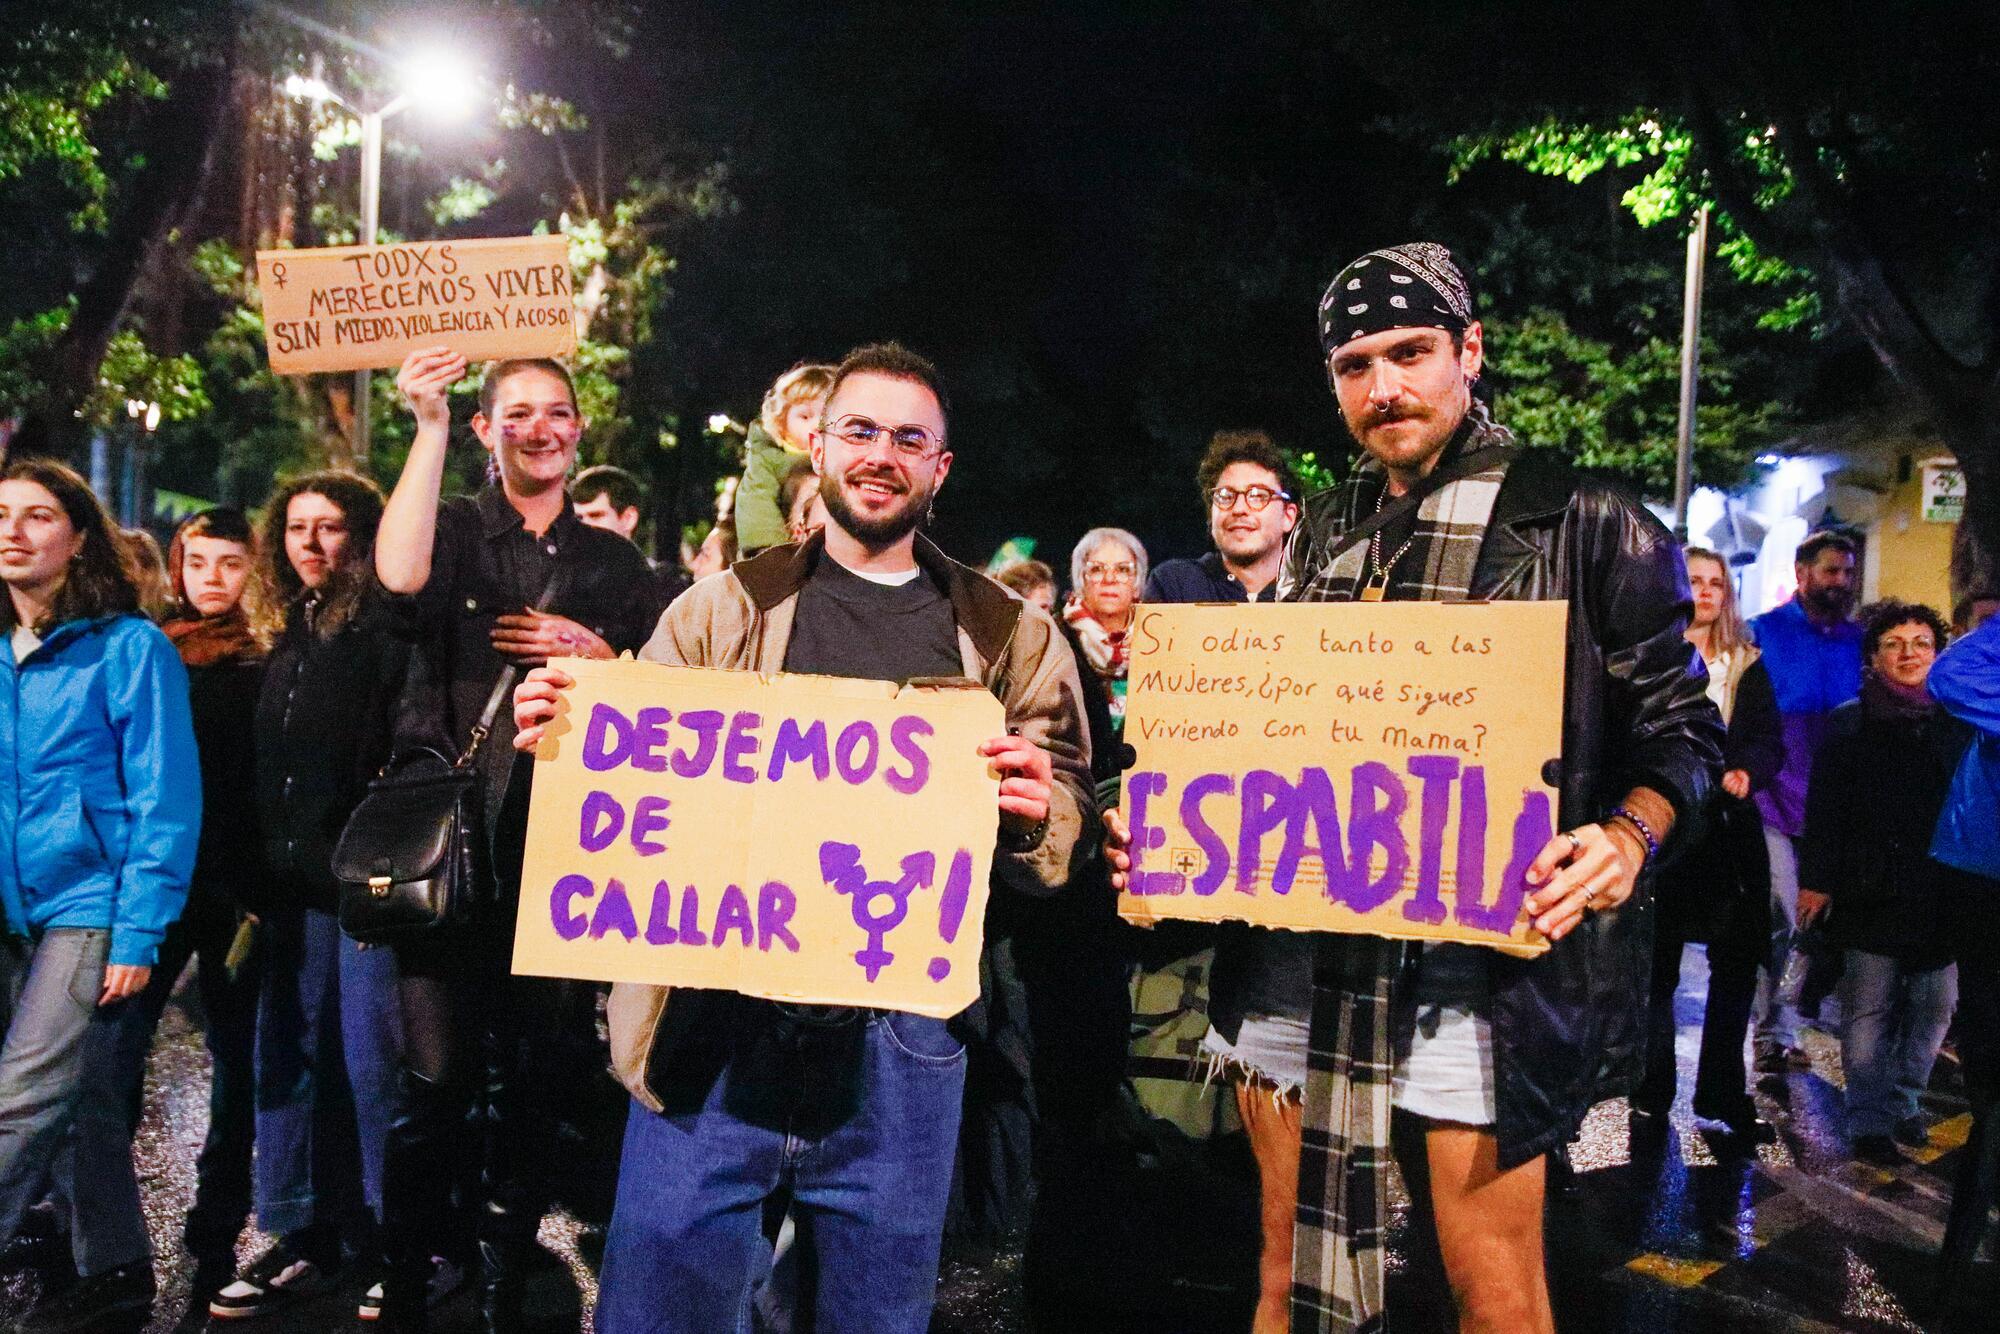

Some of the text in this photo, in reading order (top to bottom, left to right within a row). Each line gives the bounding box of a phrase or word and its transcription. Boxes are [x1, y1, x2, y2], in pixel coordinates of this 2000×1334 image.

[343, 245, 457, 282] TODXS
[309, 264, 568, 317] MERECEMOS VIVER
[273, 316, 320, 354] SIN
[399, 311, 494, 340] VIOLENCIA
[492, 304, 510, 330] Y
[1140, 613, 1491, 655] Si odias tanto a las
[1337, 680, 1384, 704] qué
[1398, 685, 1477, 715] sigues
[582, 702, 934, 794] DEJEMOS
[1332, 719, 1363, 742] tu
[580, 791, 670, 856] DE
[550, 874, 799, 952] CALLAR
